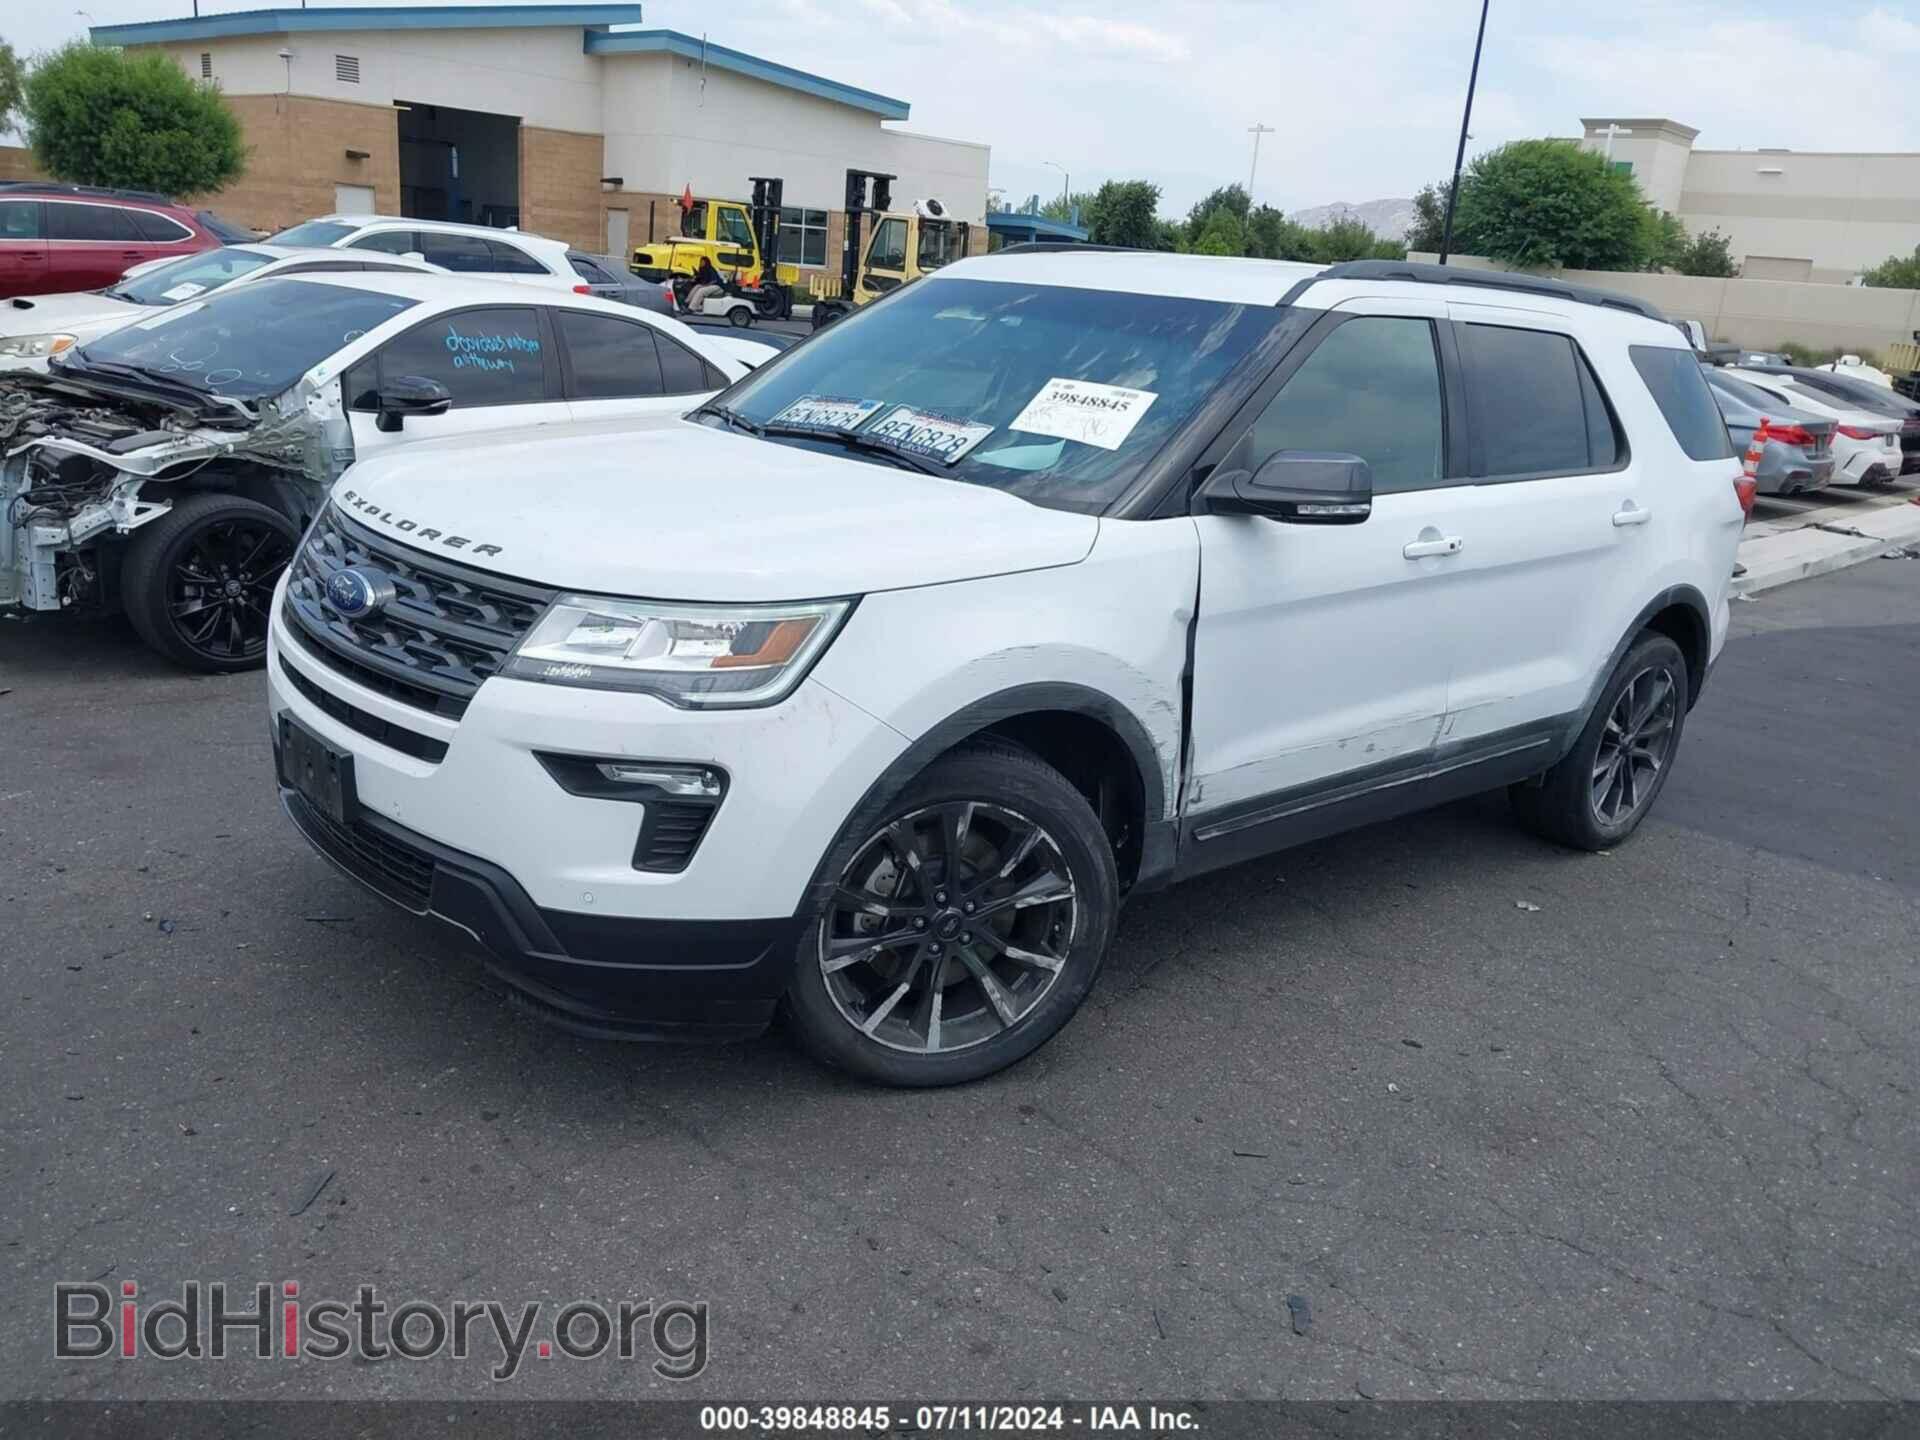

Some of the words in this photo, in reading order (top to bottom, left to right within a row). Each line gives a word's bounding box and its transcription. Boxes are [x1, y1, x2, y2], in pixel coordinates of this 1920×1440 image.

[1046, 390, 1132, 412] 39848845
[877, 420, 968, 453] 8ENG828
[343, 490, 504, 557] EXPLORER
